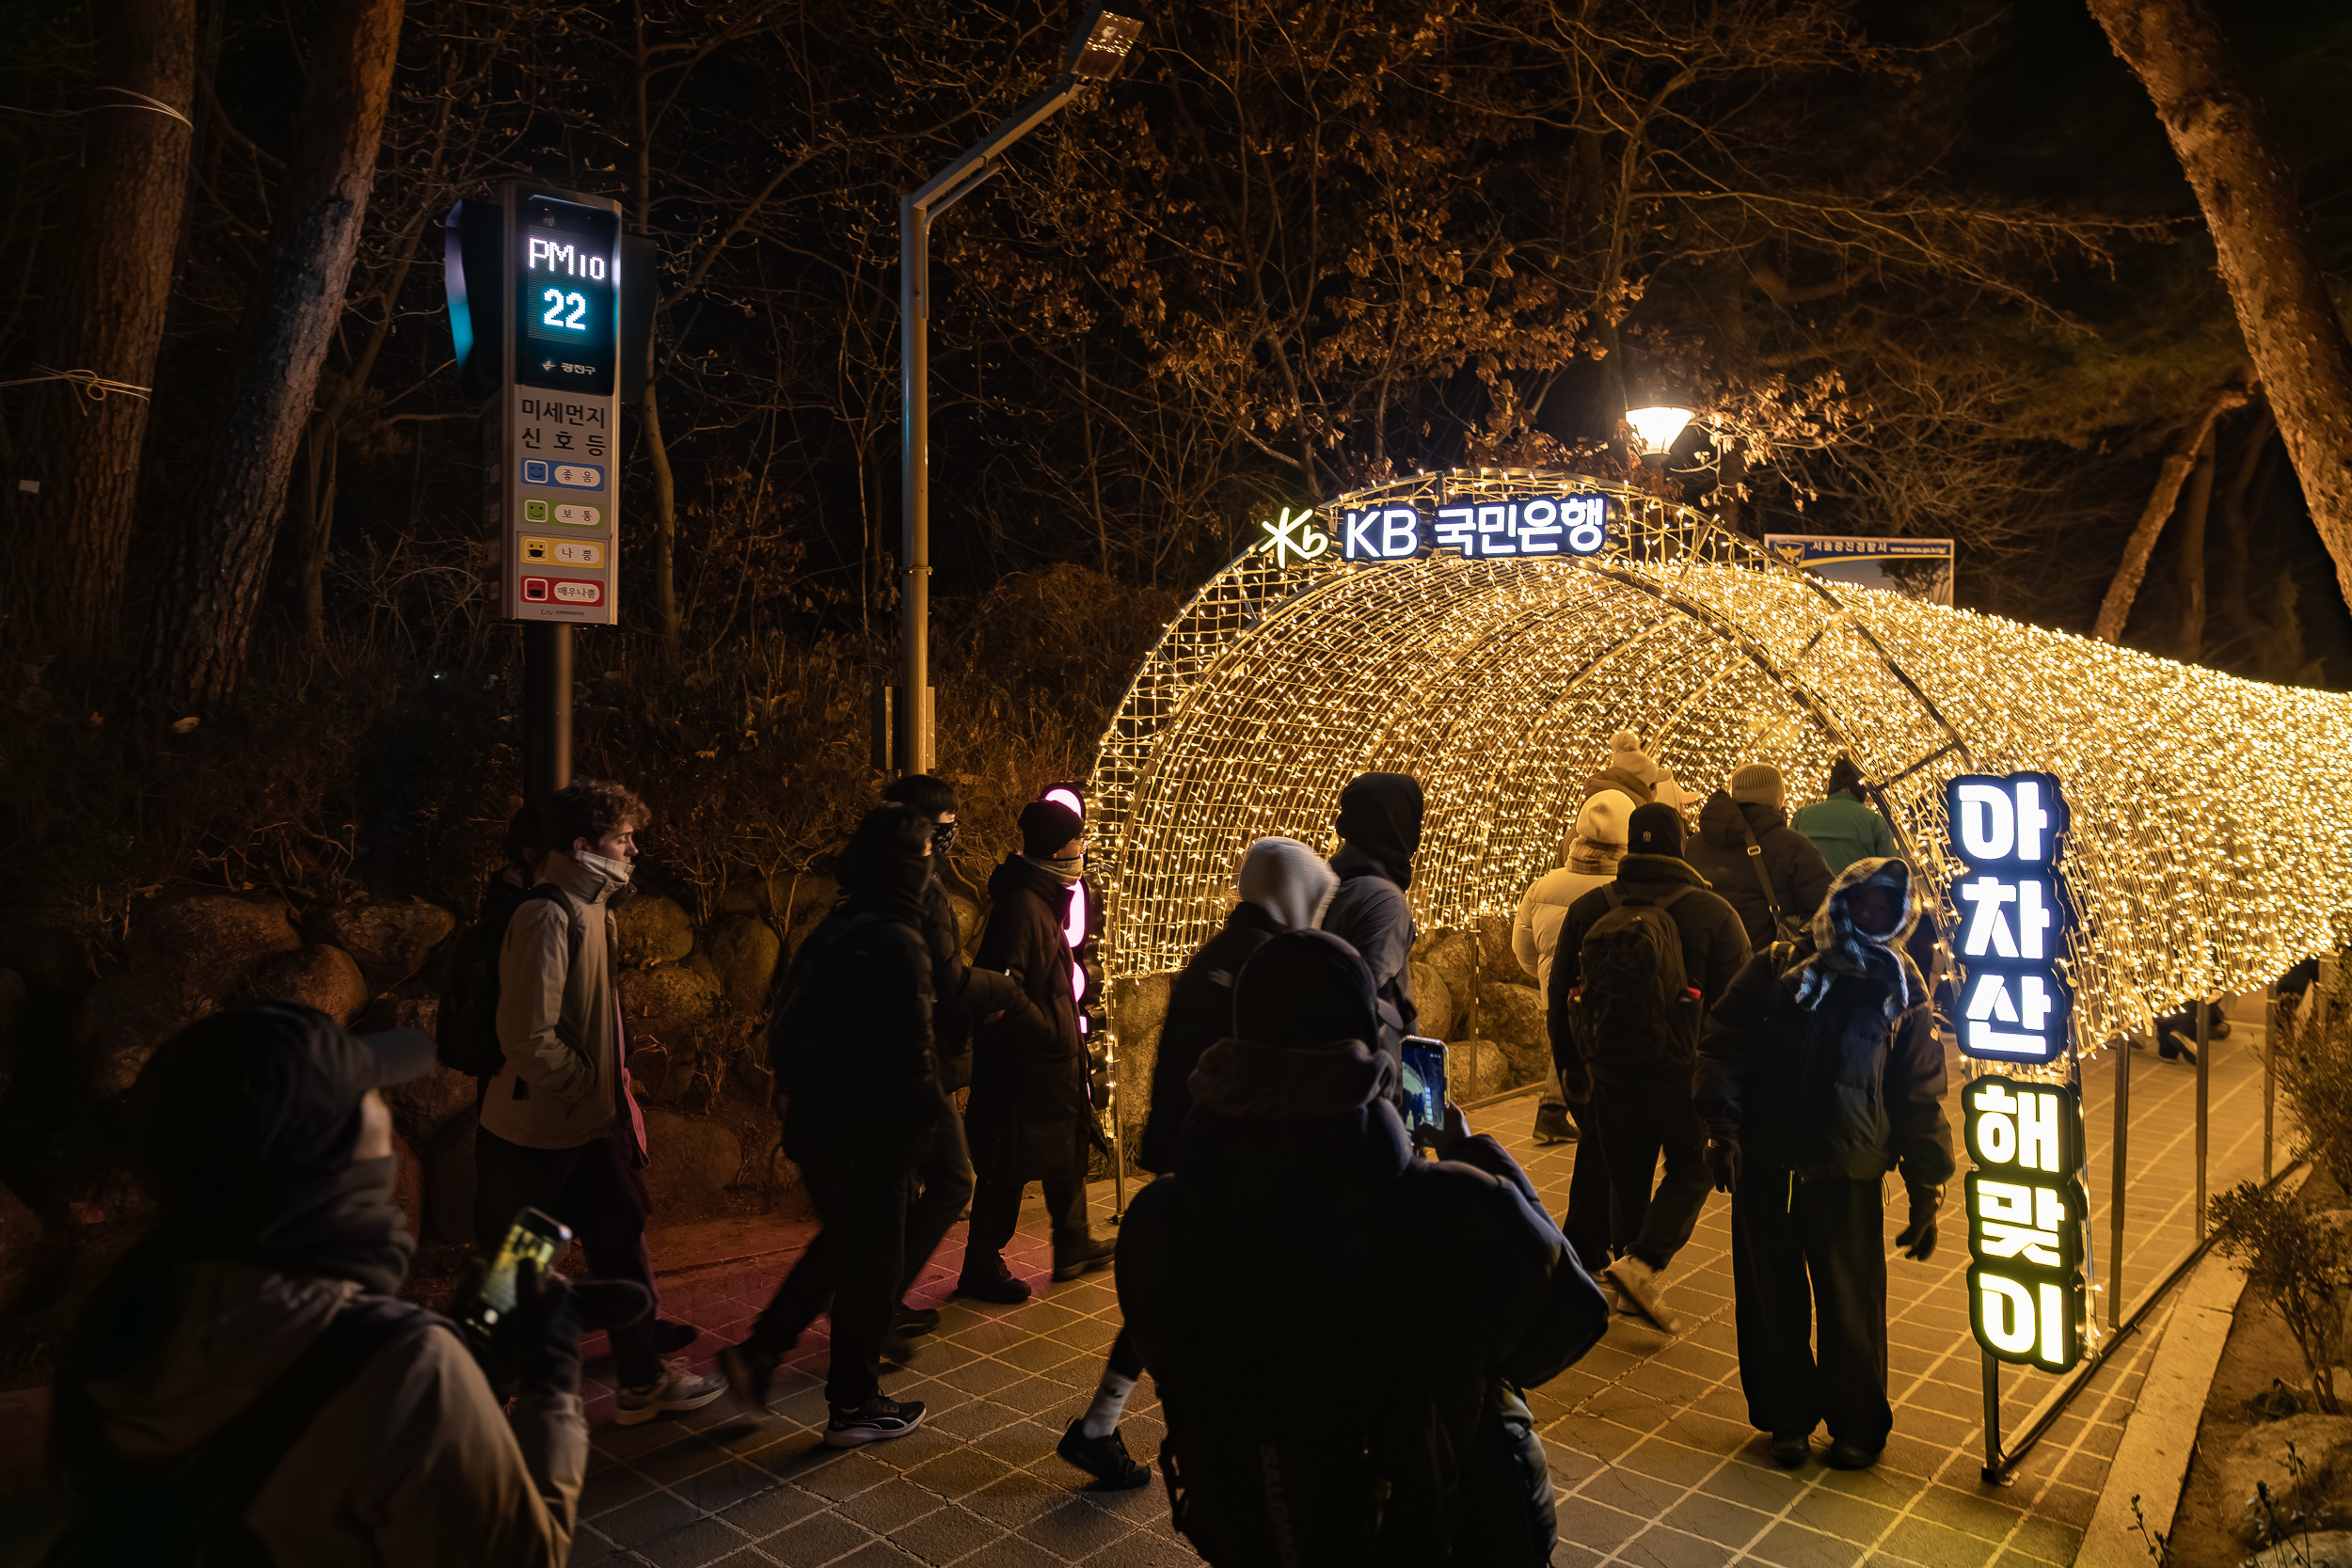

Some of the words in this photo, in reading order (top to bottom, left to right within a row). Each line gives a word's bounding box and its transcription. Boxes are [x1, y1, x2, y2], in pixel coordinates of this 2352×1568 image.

[543, 288, 586, 330] 22
[560, 362, 596, 375] 광진구
[521, 399, 605, 430] 미세먼지
[1345, 508, 1419, 559] KB
[1435, 497, 1604, 557] 국민은행
[557, 586, 596, 599] 매우나쁨
[1957, 781, 2054, 1055] 아차산
[1974, 1083, 2066, 1366] 해맞이
